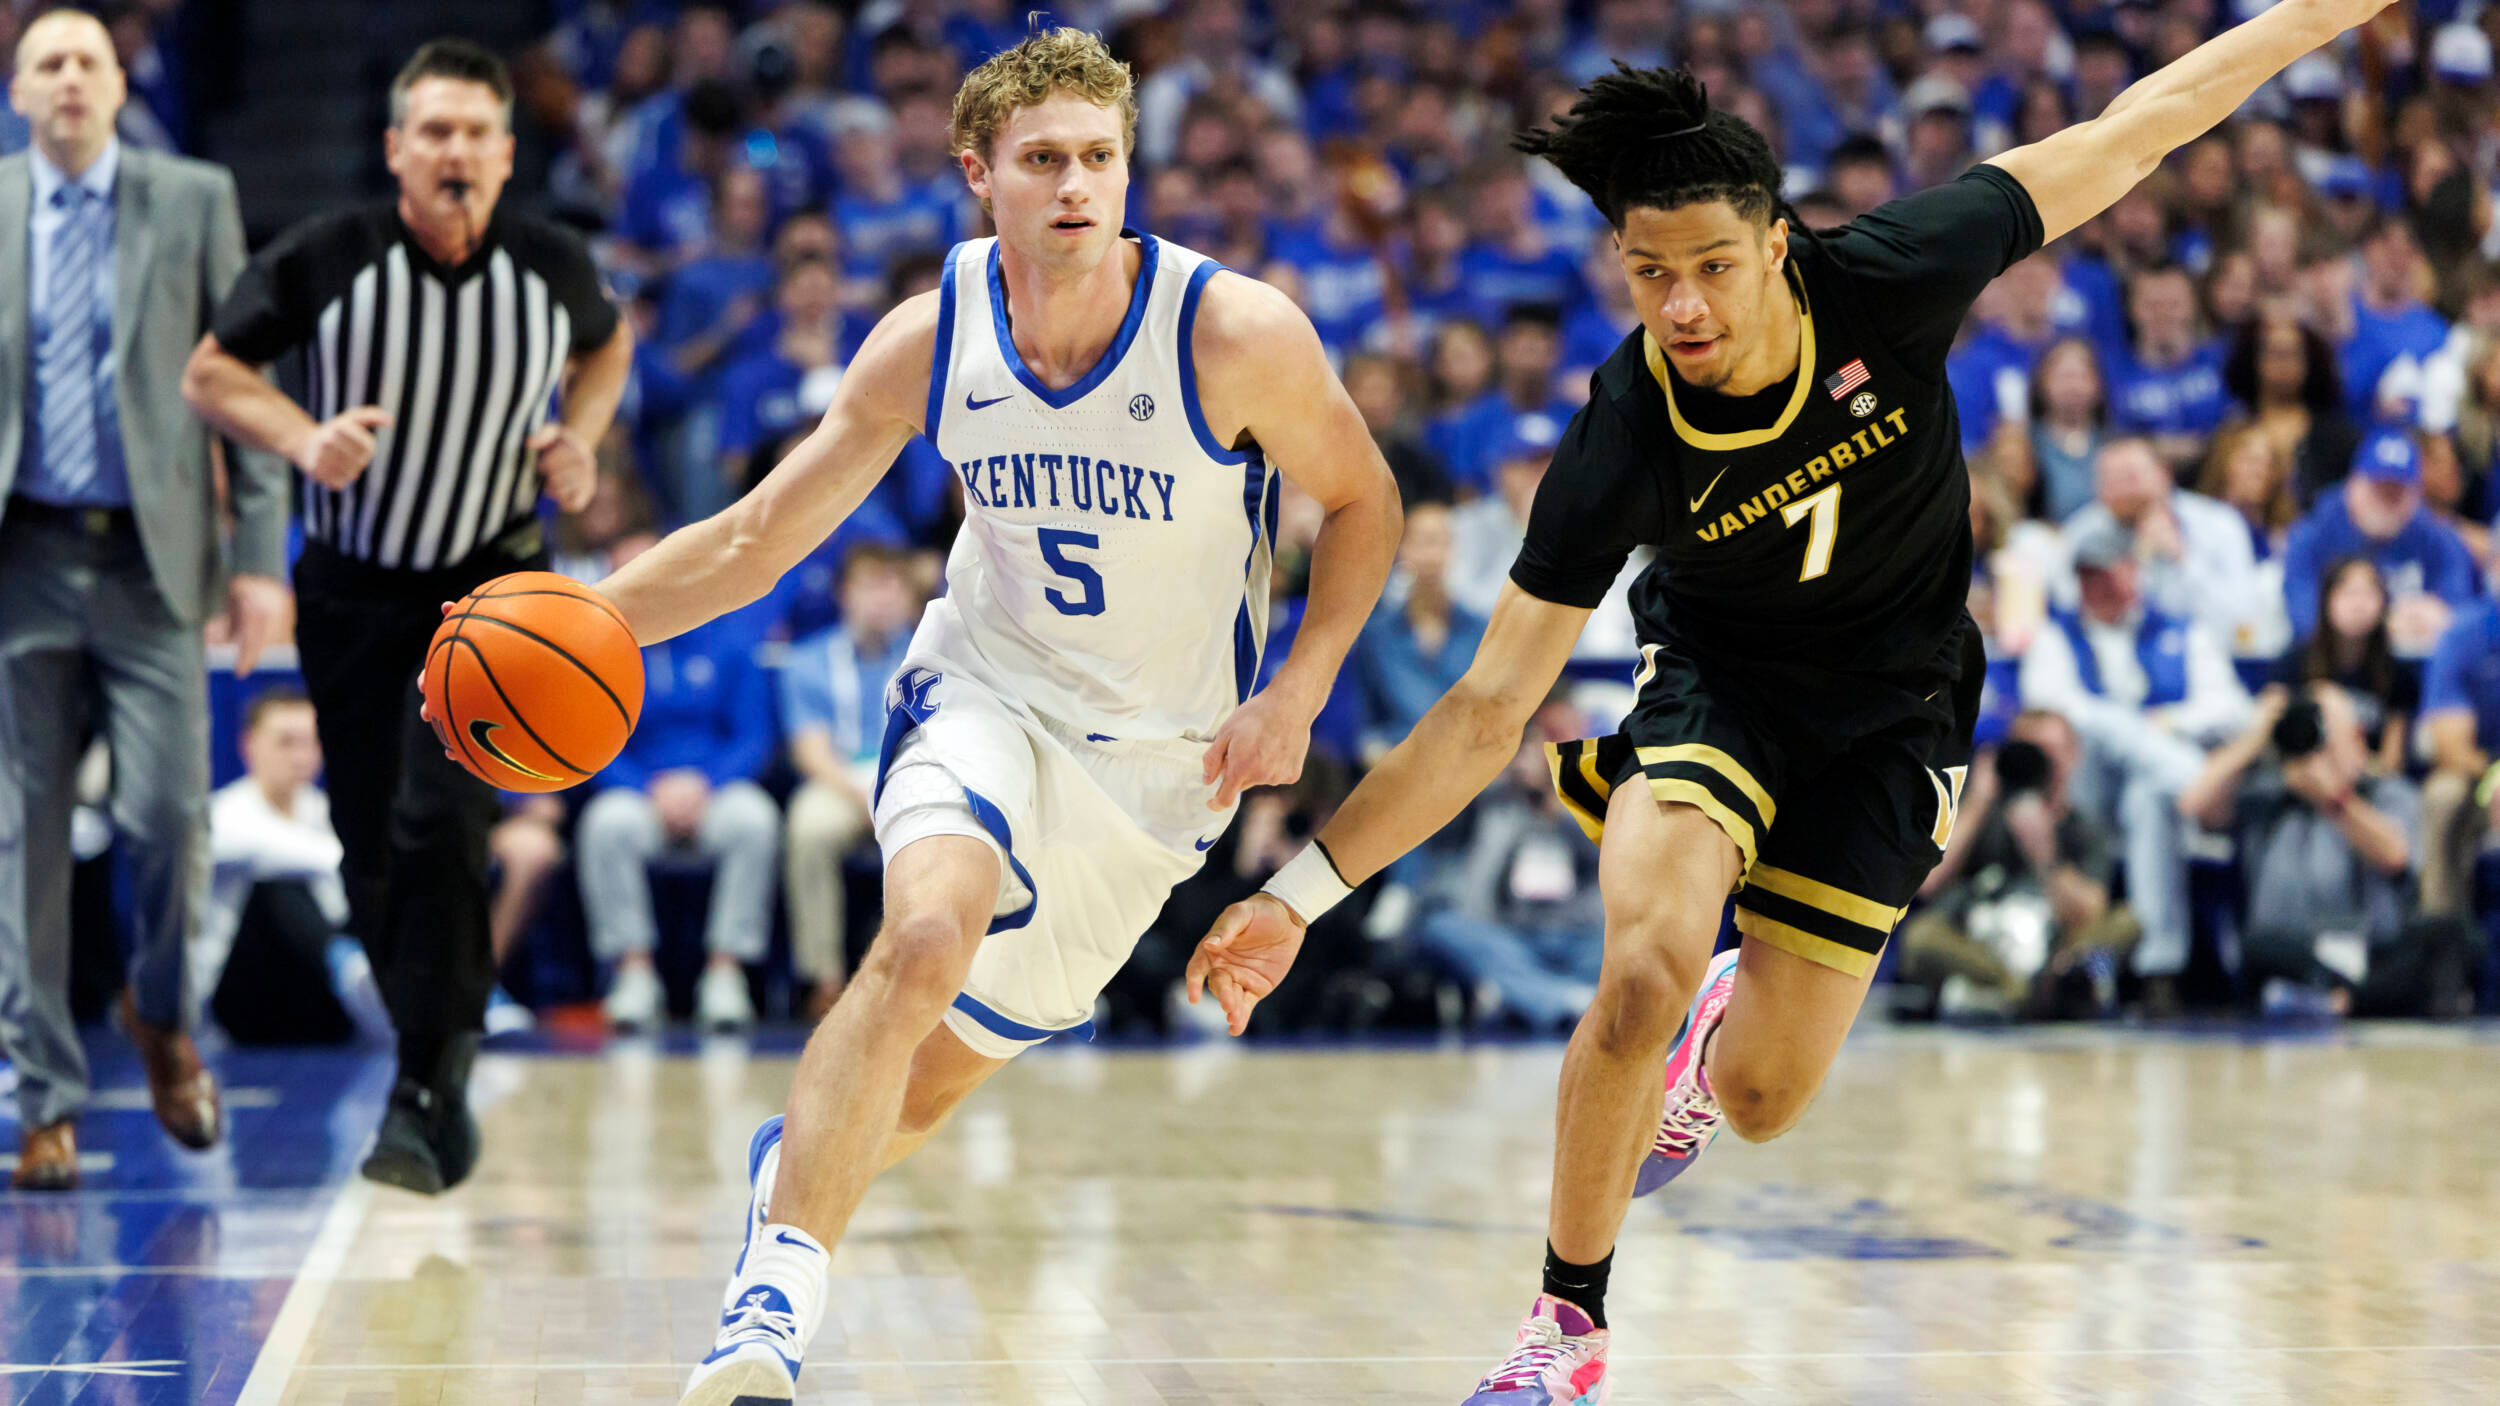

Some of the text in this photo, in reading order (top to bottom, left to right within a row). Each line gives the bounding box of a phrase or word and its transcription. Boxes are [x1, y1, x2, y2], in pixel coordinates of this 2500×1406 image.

[1130, 395, 1155, 420] SEC
[1852, 394, 1876, 416] SEC
[961, 453, 1176, 521] KENTUCKY
[1696, 408, 1909, 543] VANDERBILT
[1781, 481, 1843, 583] 7
[1037, 527, 1106, 617] 5
